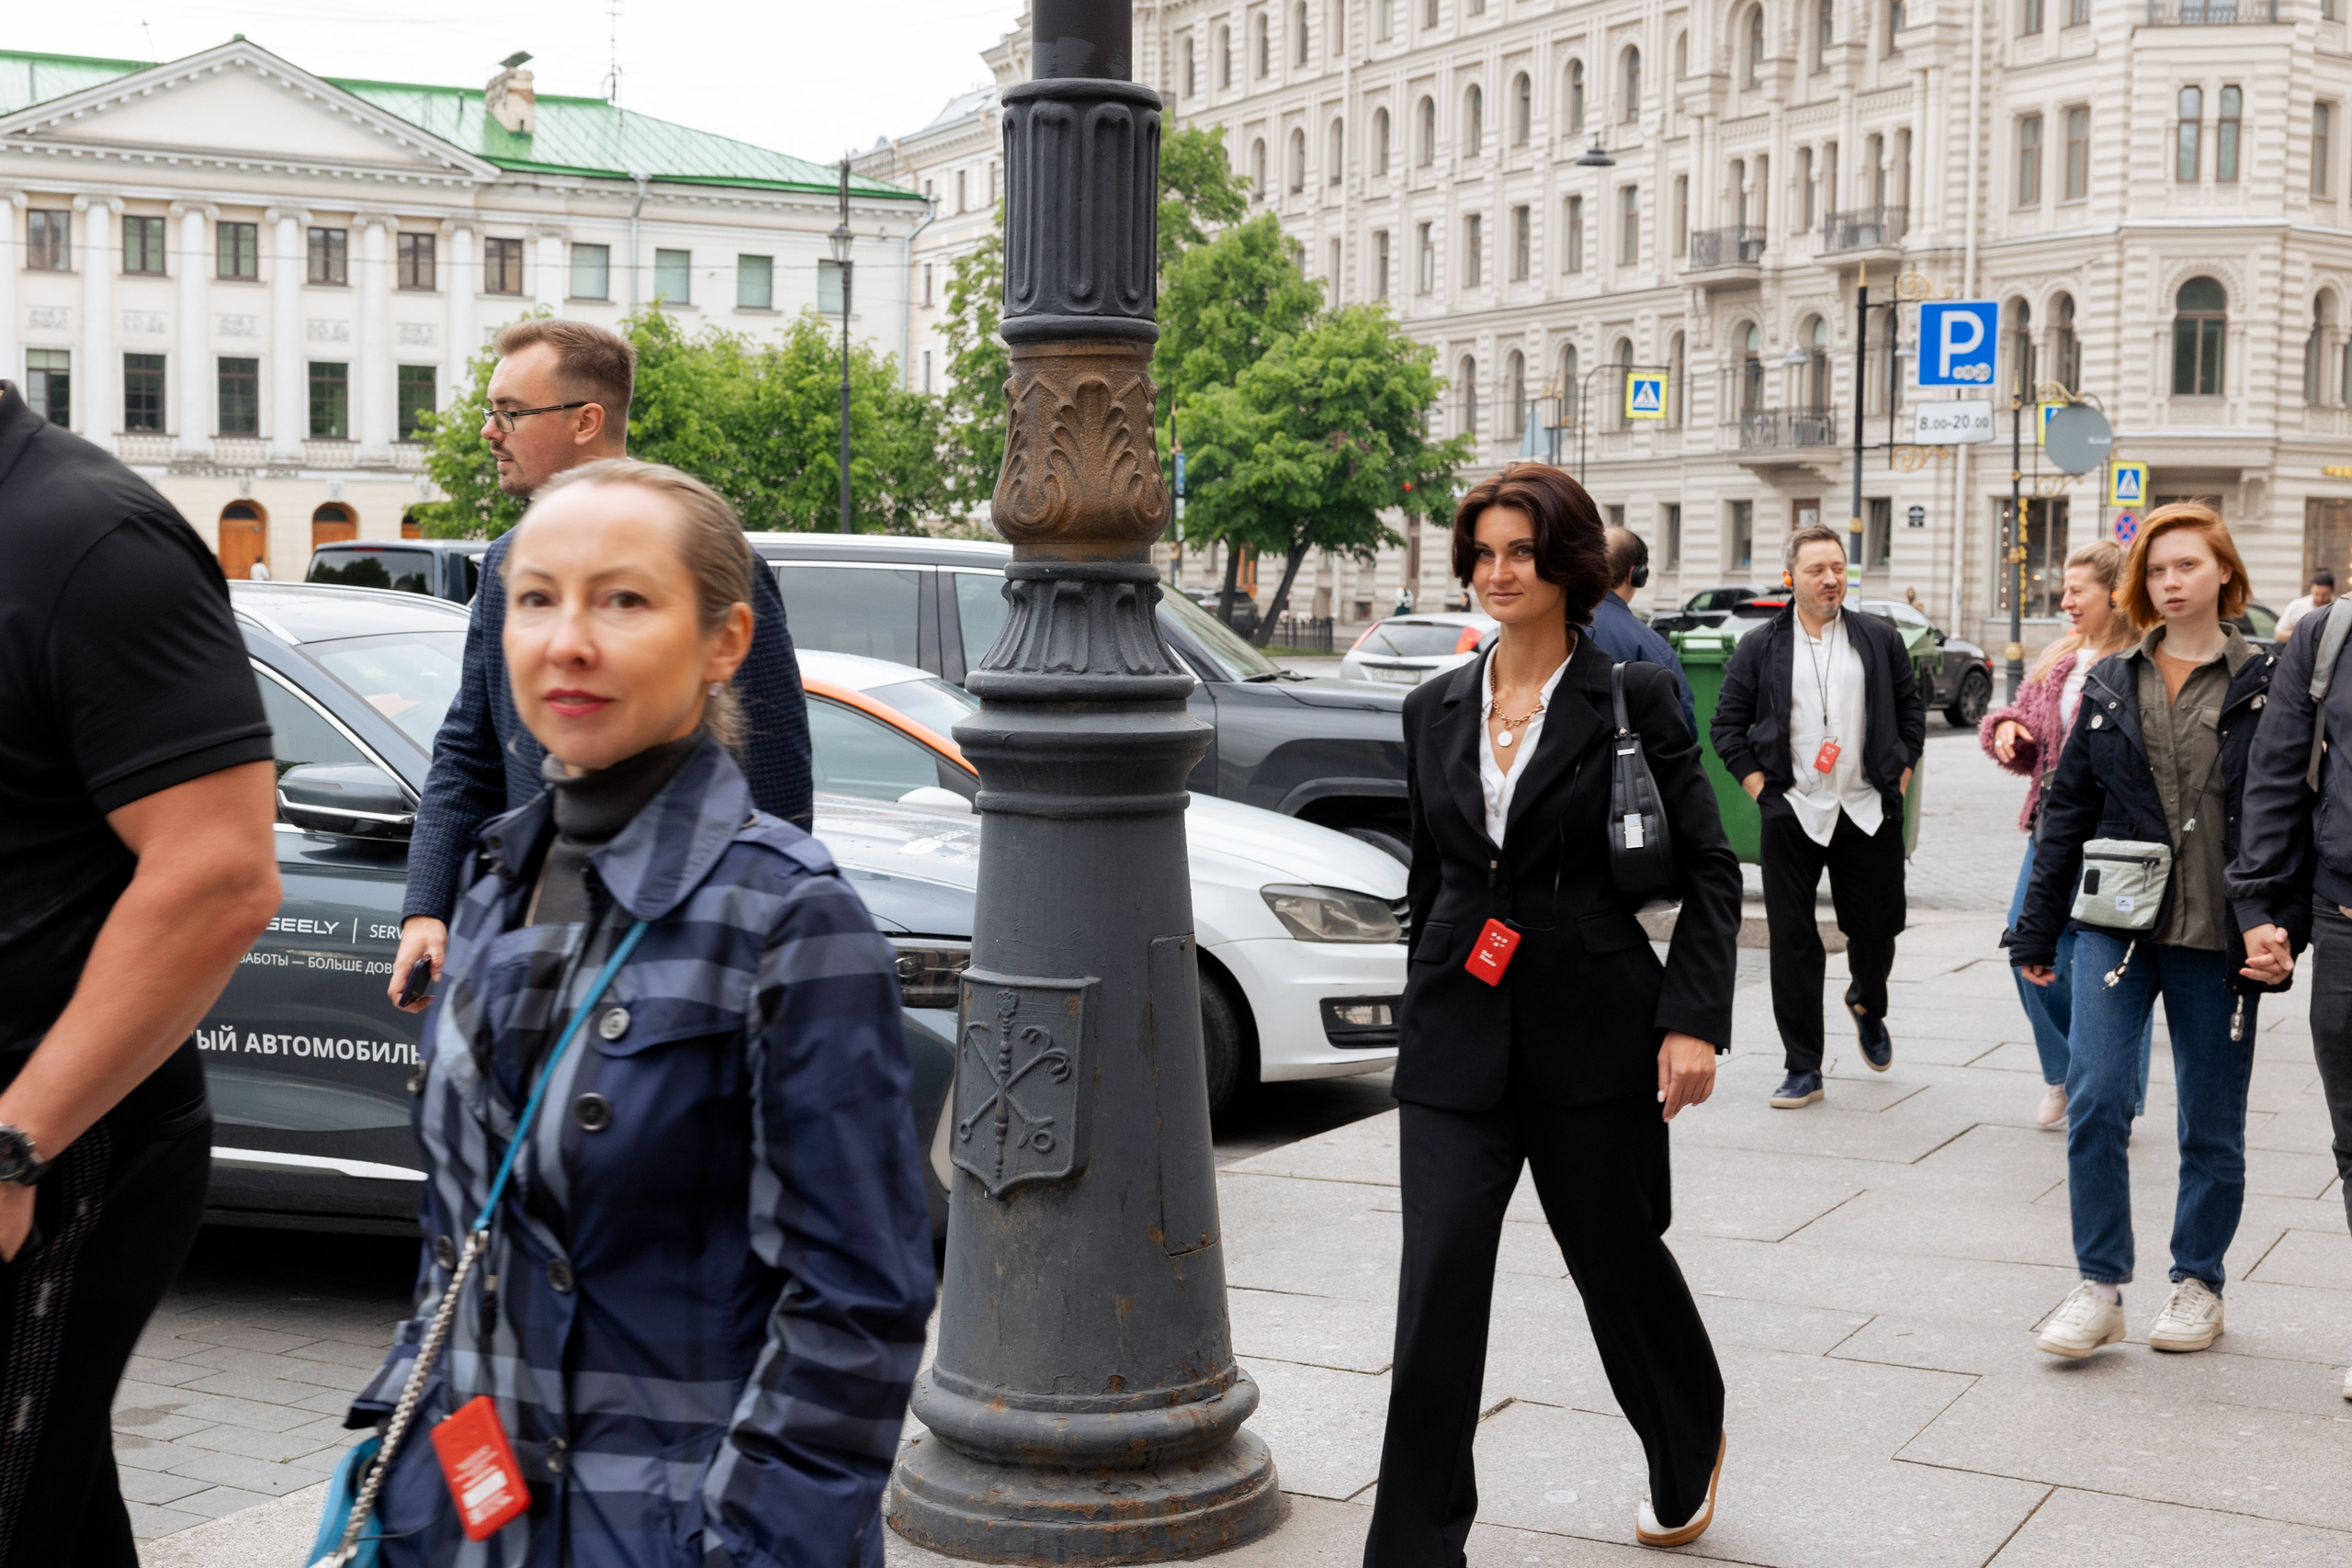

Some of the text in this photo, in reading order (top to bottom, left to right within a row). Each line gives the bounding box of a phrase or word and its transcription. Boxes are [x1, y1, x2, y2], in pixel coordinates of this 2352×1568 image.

[1939, 310, 1984, 378] P
[308, 956, 362, 972] БОЛЬШЕ
[365, 961, 395, 975] ДОВ
[192, 1024, 421, 1066] ЫЙ АВТОМОБИЛЬ
